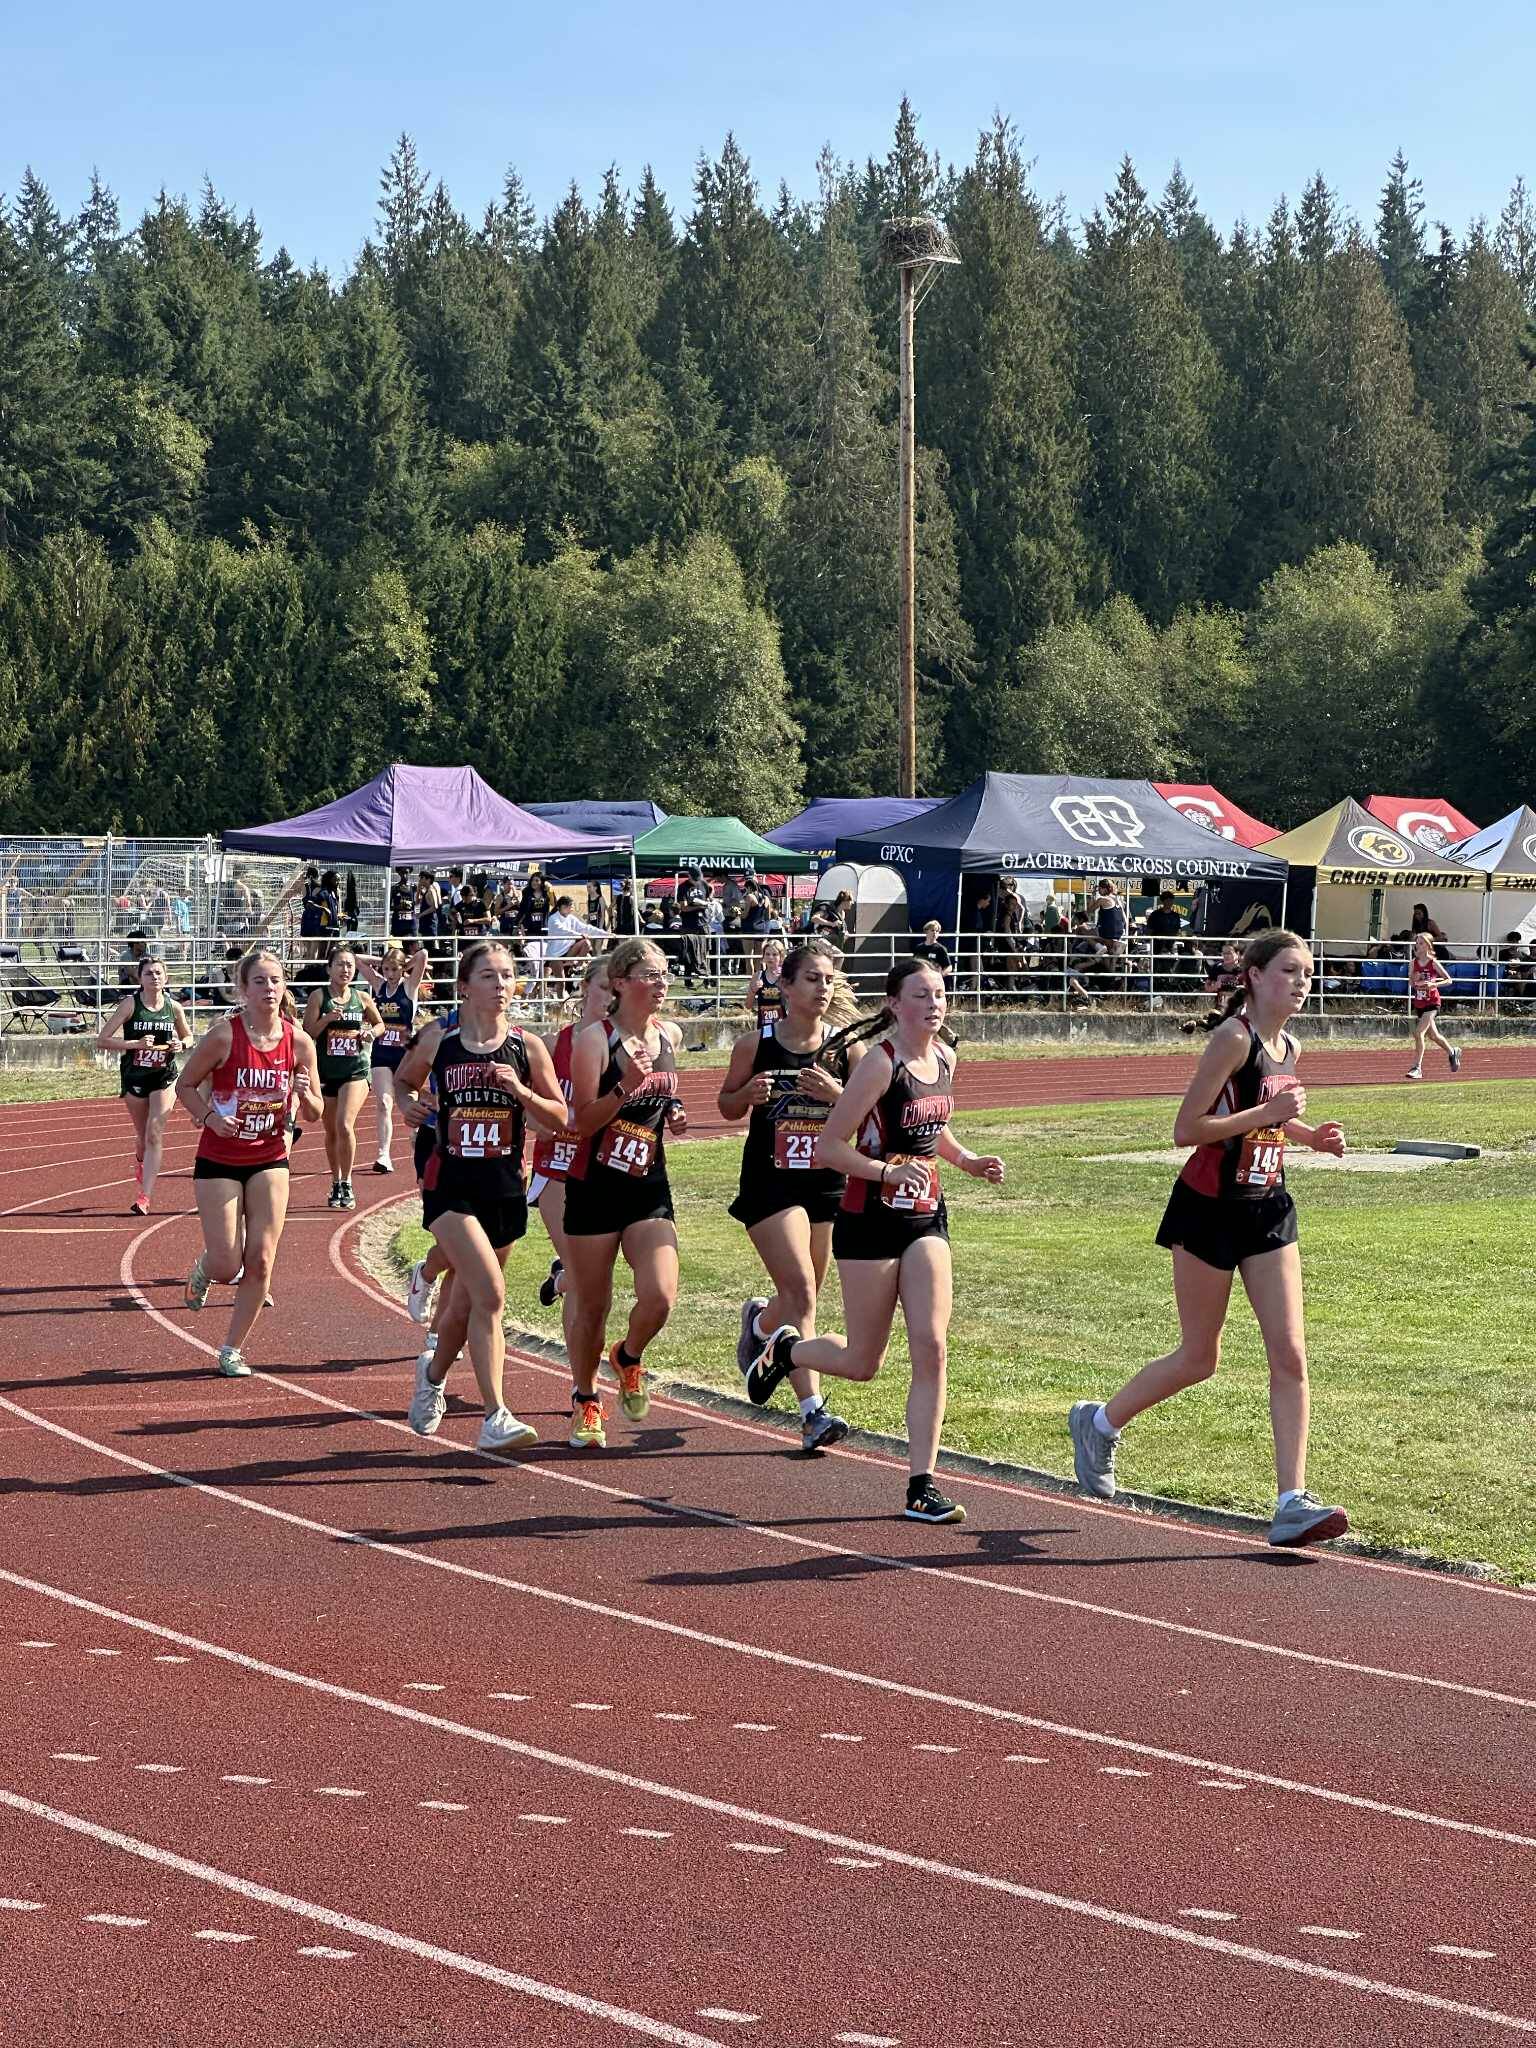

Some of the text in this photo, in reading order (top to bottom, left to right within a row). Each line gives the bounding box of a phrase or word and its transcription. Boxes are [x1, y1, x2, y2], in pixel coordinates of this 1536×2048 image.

[1050, 795, 1146, 848] GP
[679, 856, 755, 869] FRANKLIN
[880, 845, 914, 864] GPXC
[1001, 852, 1252, 878] GLACIER PEAK CROSS COUNTRY
[1329, 869, 1474, 889] CROSS COUNTRY
[763, 1010, 779, 1020] 200
[330, 1037, 357, 1051] 1243
[384, 1030, 401, 1042] 201
[137, 1049, 166, 1062] 1245
[236, 1067, 289, 1092] KING'S
[454, 1091, 509, 1105] WOLVES
[244, 1113, 275, 1132] 560
[460, 1122, 501, 1147] 144
[553, 1141, 578, 1163] 55
[610, 1136, 649, 1167] 143
[1249, 1145, 1282, 1173] 145
